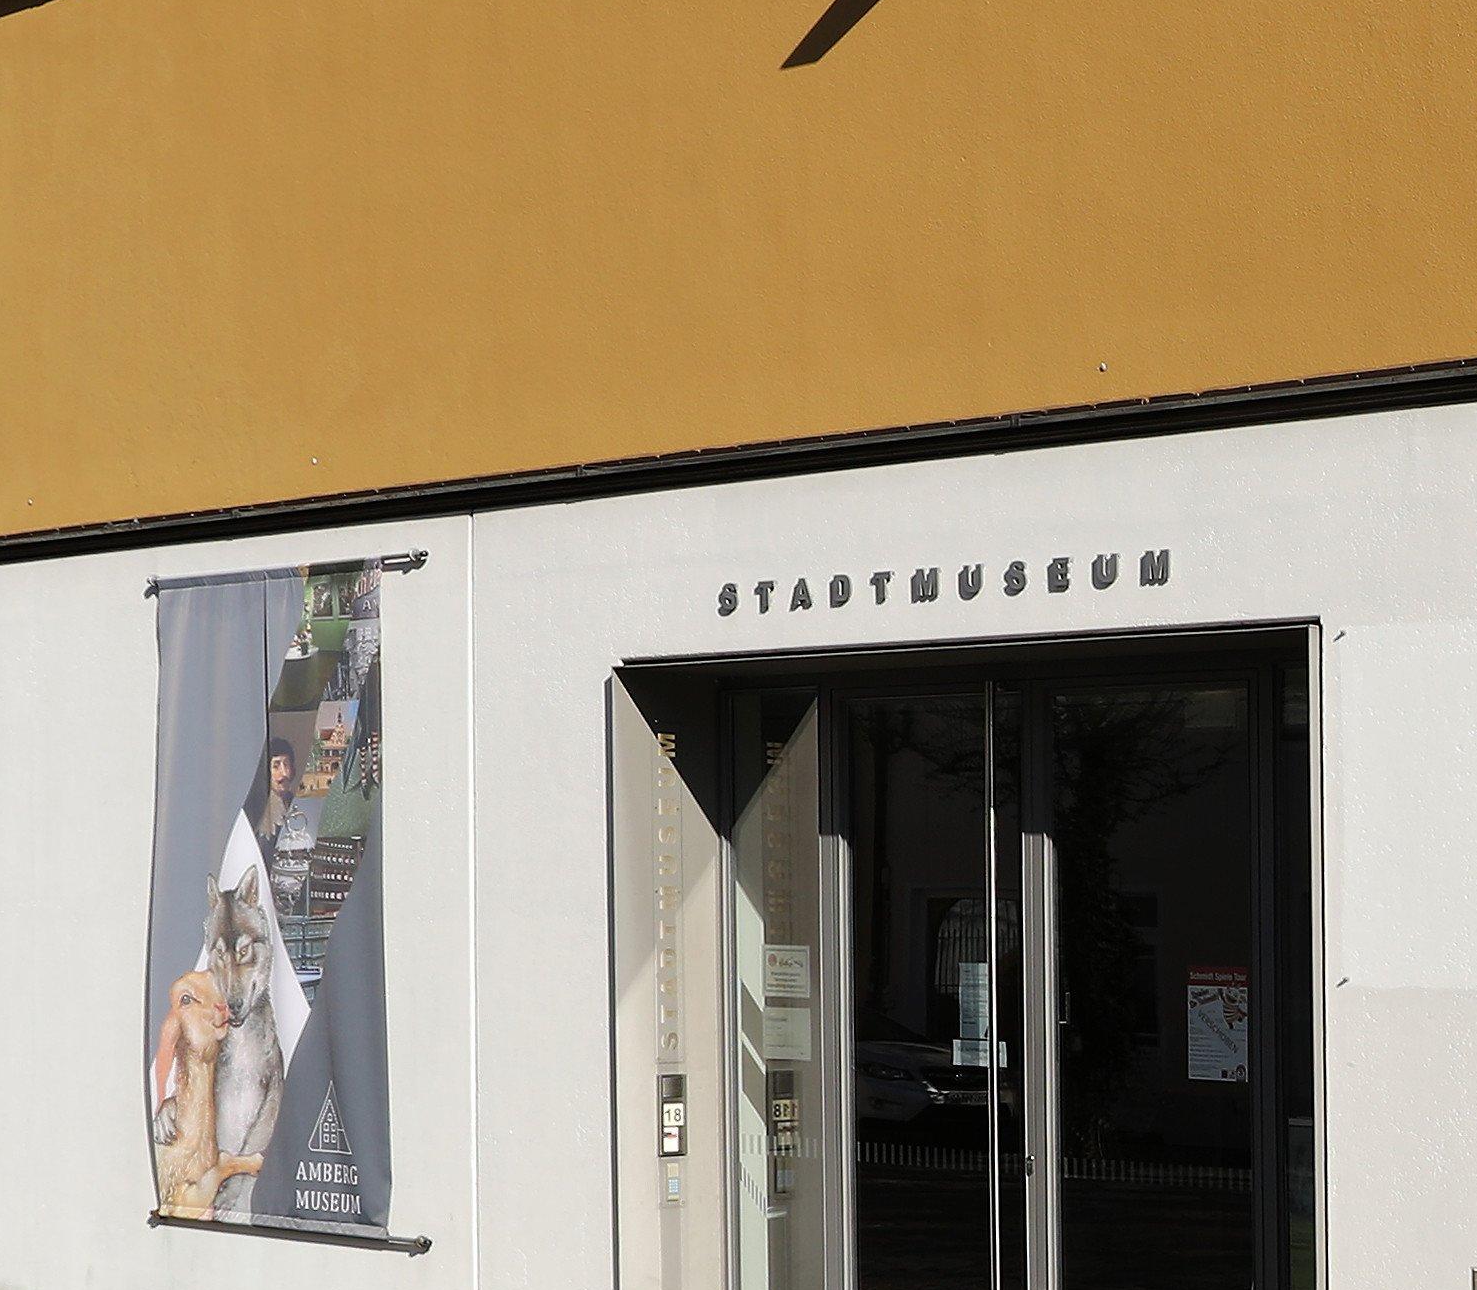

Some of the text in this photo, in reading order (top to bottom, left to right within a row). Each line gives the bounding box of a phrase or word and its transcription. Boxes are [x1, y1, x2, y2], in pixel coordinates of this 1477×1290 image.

[717, 549, 1170, 617] STADTMUSEUM
[664, 1108, 682, 1122] 18
[296, 1161, 358, 1185] AMBERG
[296, 1189, 362, 1214] MUSEUM
